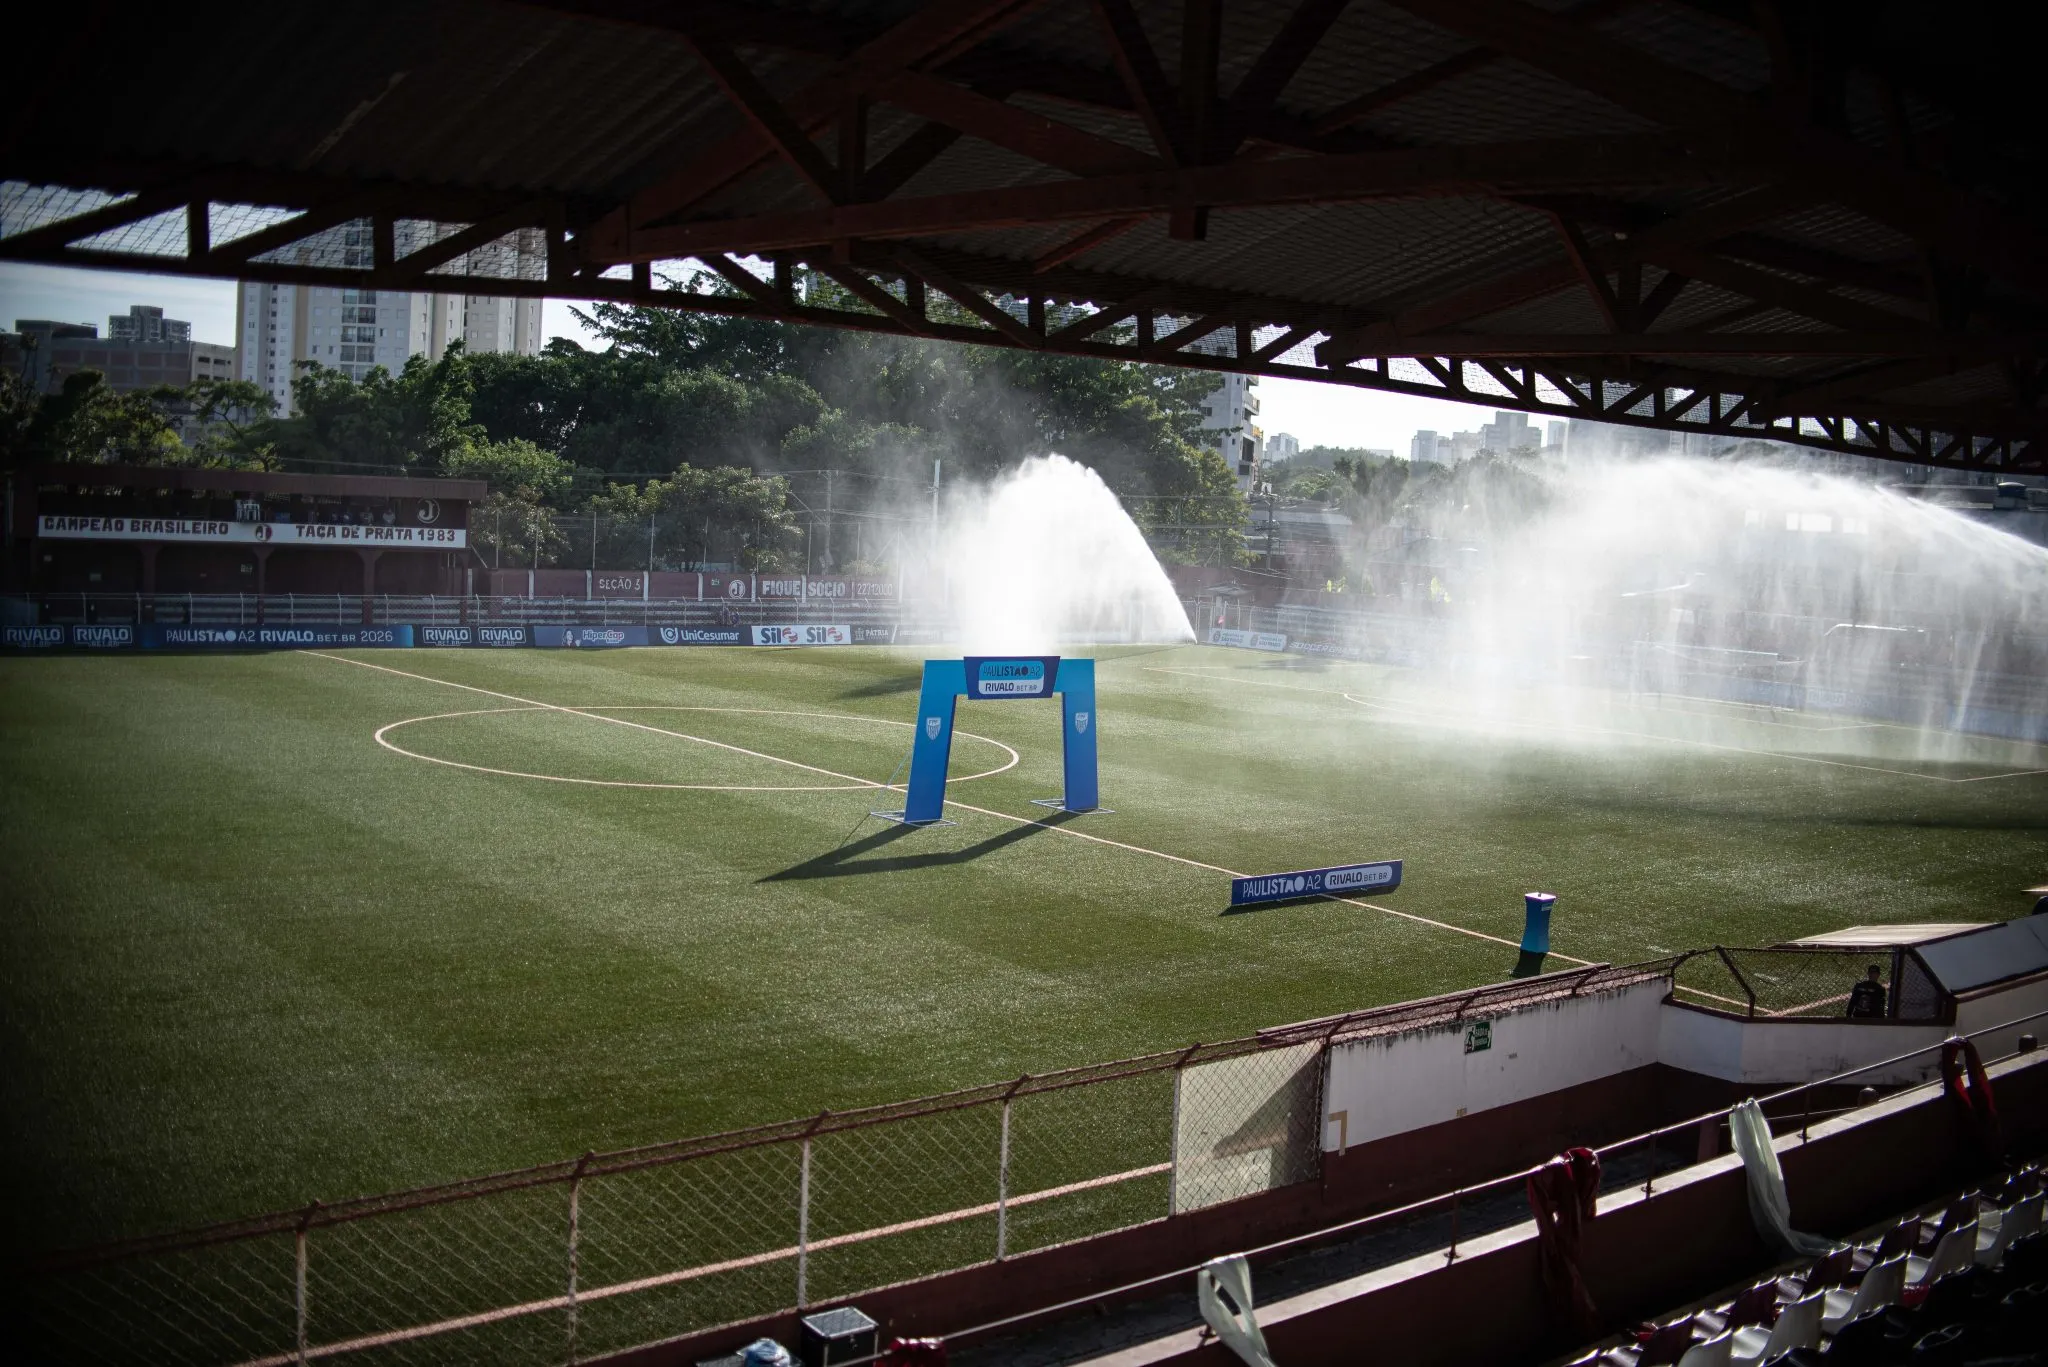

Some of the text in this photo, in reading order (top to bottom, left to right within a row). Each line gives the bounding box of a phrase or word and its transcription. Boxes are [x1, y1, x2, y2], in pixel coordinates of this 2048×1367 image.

[130, 520, 229, 535] BRASILEIRO
[342, 526, 359, 539] DE
[365, 527, 412, 541] PRATA
[418, 528, 455, 541] 1983
[599, 576, 632, 591] SEÇÃO
[762, 580, 845, 597] FIQUE SÓCIO
[7, 628, 61, 641] RIVALO
[77, 628, 129, 641] RIVALO
[238, 630, 256, 642] A2
[360, 631, 393, 642] 2026
[425, 629, 469, 641] RIVALO
[481, 629, 524, 641] RIVALO
[681, 629, 740, 641] UniCesumar
[760, 627, 782, 644] Sil
[806, 627, 827, 643] Sil
[1305, 874, 1321, 891] A2
